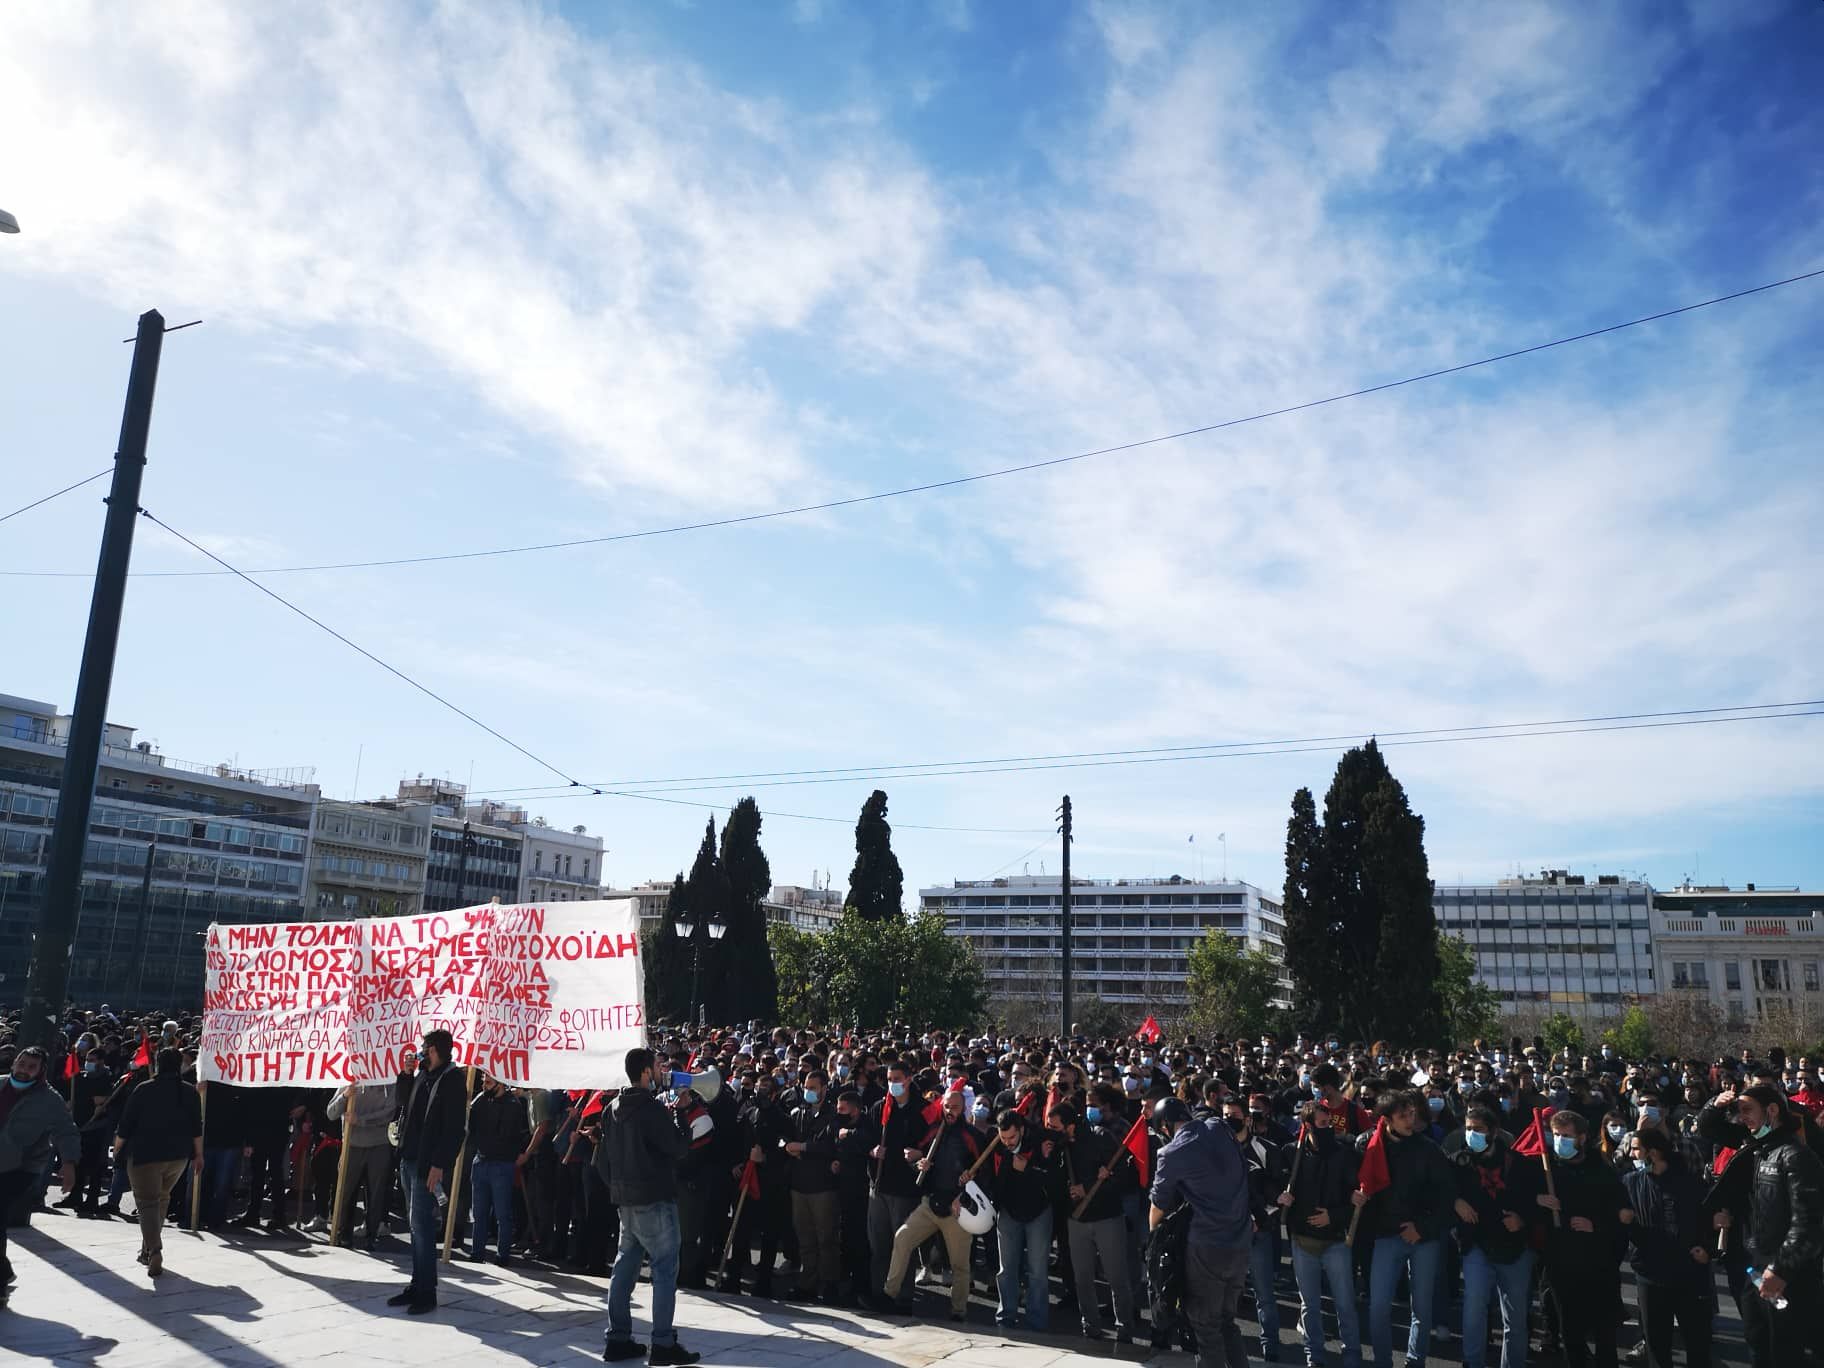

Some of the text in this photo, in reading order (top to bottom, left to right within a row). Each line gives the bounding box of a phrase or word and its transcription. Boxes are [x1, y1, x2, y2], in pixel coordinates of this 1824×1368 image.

[228, 926, 278, 950] ΜΗΝ
[371, 922, 406, 947] ΝΑ
[412, 916, 449, 943] ΤΟ
[219, 971, 242, 991] ΟΧΙ
[246, 971, 299, 991] ΣΤΗΝ
[423, 975, 464, 1000] ΚΑΙ
[277, 1011, 311, 1031] ΔΕΝ
[380, 996, 446, 1021] ΣΧΟΛΕΣ
[560, 1004, 643, 1032] ΦΟΙΤΗΤΕΣ
[247, 1031, 304, 1052] ΚΙΝΗΜΑ
[307, 1030, 331, 1051] ΘΑ
[360, 1028, 374, 1051] ΤΑ
[375, 1019, 424, 1049] ΣΧΕΔΙΑ
[474, 1043, 530, 1081] ΕΜΠ
